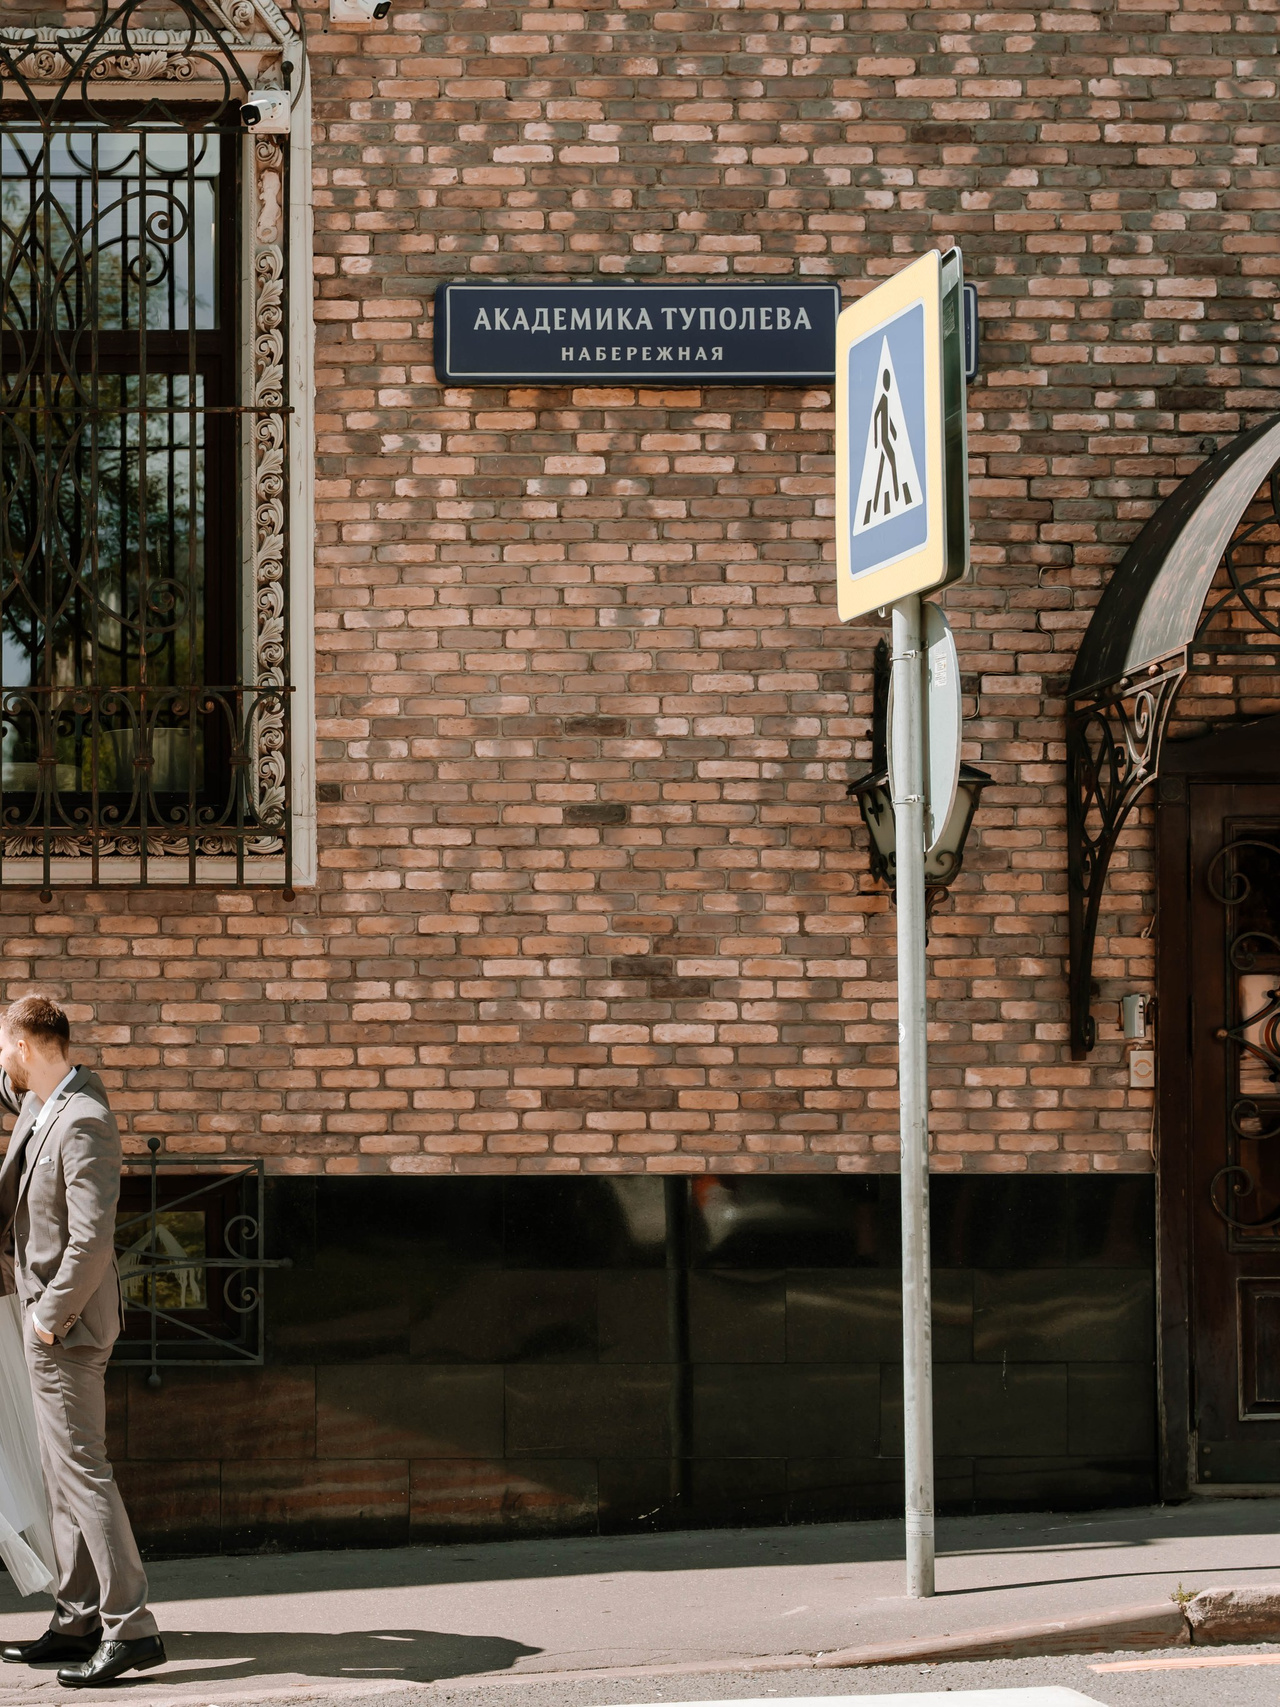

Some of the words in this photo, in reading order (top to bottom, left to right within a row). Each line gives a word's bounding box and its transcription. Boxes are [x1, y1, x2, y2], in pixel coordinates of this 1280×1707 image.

[473, 306, 654, 335] АКАДЕМИКА
[661, 305, 813, 332] ТУПОЛЕВА
[560, 345, 725, 362] НАБЕРЕЖНАЯ
